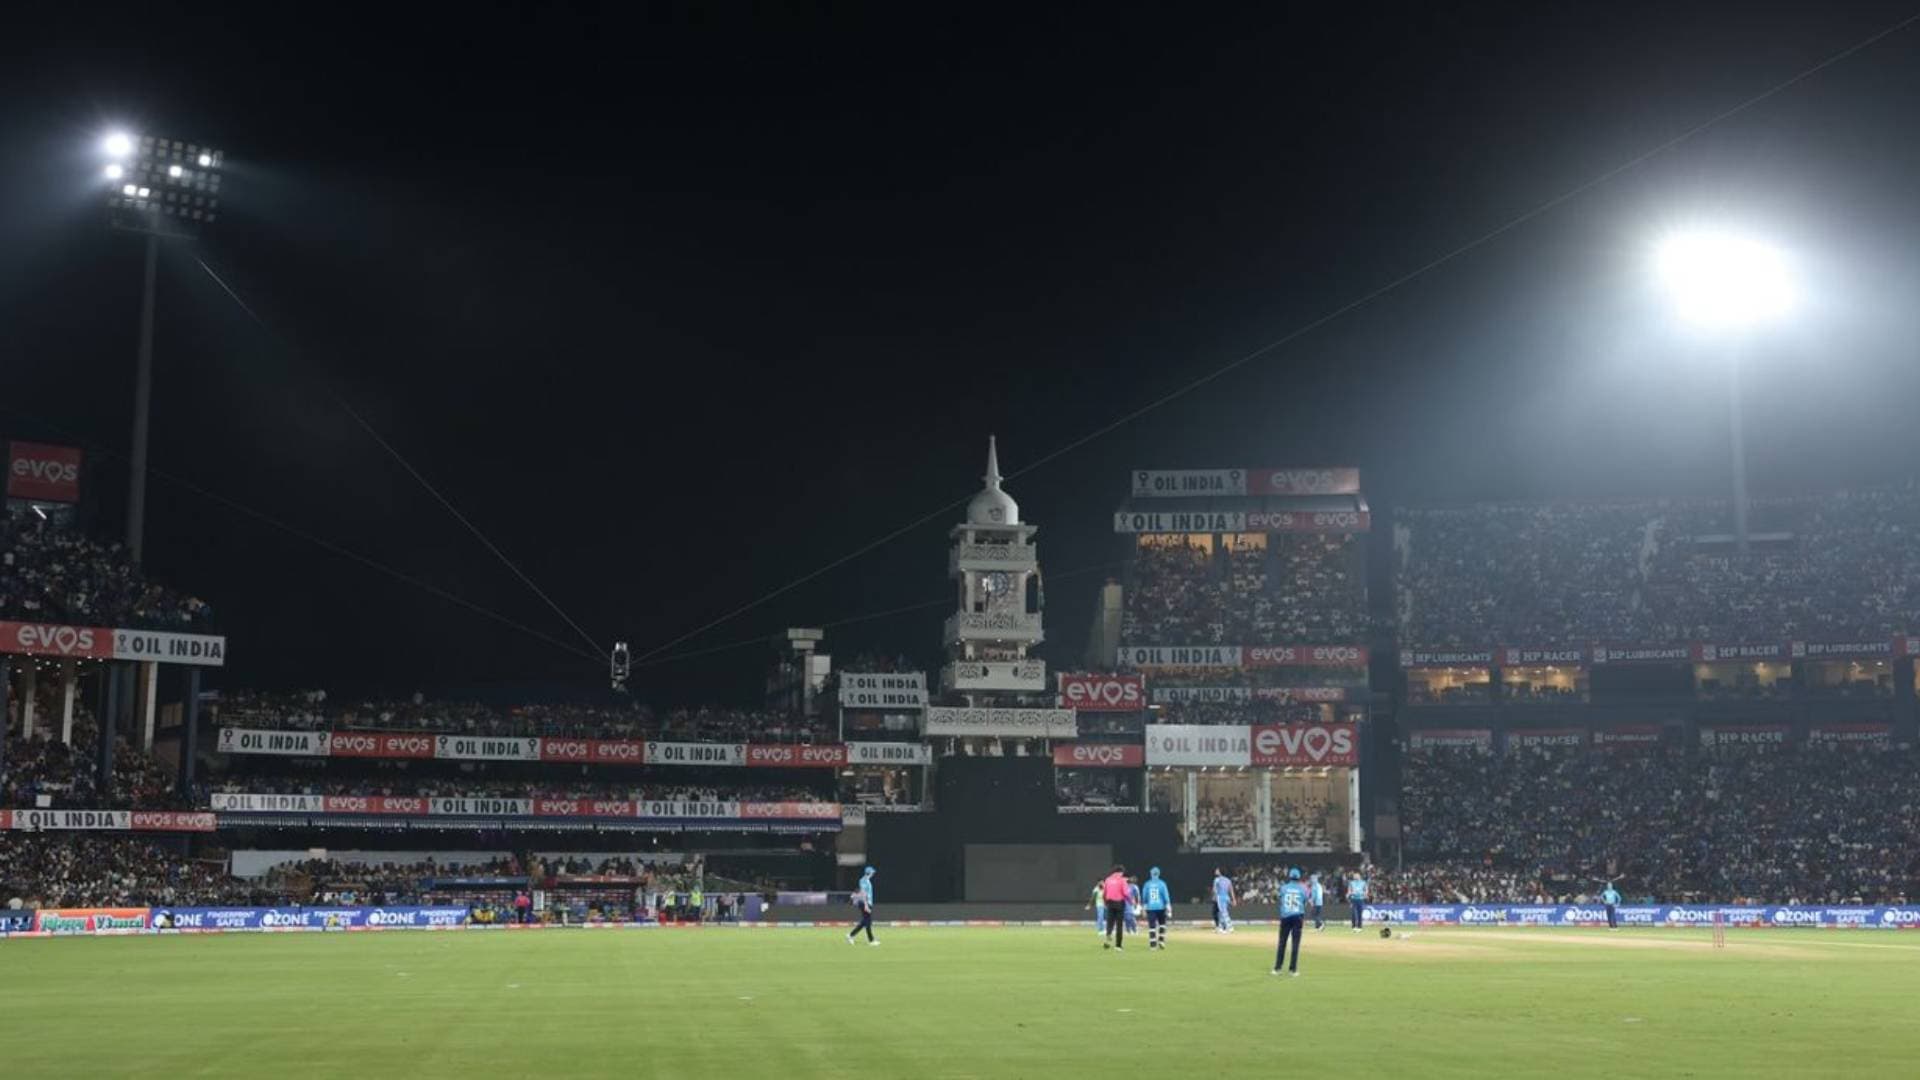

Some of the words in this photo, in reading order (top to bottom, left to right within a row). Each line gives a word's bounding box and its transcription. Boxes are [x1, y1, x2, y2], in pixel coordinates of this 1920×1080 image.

[13, 458, 78, 483] evos
[1155, 477, 1177, 490] OIL
[1182, 475, 1223, 490] INDIA
[1271, 471, 1334, 490] evos
[1132, 515, 1162, 530] OIL
[1172, 514, 1227, 529] INDIA
[1249, 512, 1293, 528] evos
[1313, 512, 1359, 528] evos
[17, 625, 94, 653] evos
[132, 636, 161, 655] OIL
[169, 639, 222, 659] INDIA
[1251, 647, 1295, 662] evos
[1313, 647, 1360, 662] evos
[1741, 645, 1778, 656] RACER
[1136, 650, 1163, 665] OIL
[1172, 650, 1222, 664] INDIA
[1544, 651, 1580, 661] RACER
[857, 678, 877, 689] OIL
[882, 678, 919, 689] INDIA
[859, 694, 877, 705] OIL
[883, 694, 919, 705] INDIA
[1067, 681, 1139, 704] evos
[240, 734, 263, 749] OIL
[268, 734, 310, 751] INDIA
[332, 737, 375, 752] evos
[386, 737, 430, 753] evos
[455, 741, 478, 755] OIL
[482, 741, 520, 755] INDIA
[545, 742, 587, 757] evos
[1163, 738, 1191, 753] OIL
[1199, 738, 1248, 753] INDIA
[1256, 727, 1352, 761] evos
[598, 743, 639, 758] evos
[664, 745, 685, 761] OIL
[689, 746, 727, 762] INDIA
[752, 748, 792, 763] evos
[802, 748, 843, 763] evos
[860, 748, 879, 759] OIL
[882, 748, 915, 760] INDIA
[1073, 746, 1123, 764] evos
[227, 797, 257, 810] OIL
[260, 798, 307, 811] INDIA
[328, 798, 367, 812] evos
[383, 798, 421, 812] evos
[443, 800, 468, 813] OIL
[474, 800, 519, 814] INDIA
[541, 801, 578, 815] evos
[594, 801, 630, 815] evos
[652, 801, 675, 816] OIL
[681, 801, 726, 816] INDIA
[746, 802, 783, 816] evos
[798, 802, 833, 816] evos
[30, 812, 58, 827] OIL
[65, 812, 115, 827] INDIA
[134, 813, 170, 827] evos
[175, 813, 214, 828] evos
[1284, 894, 1301, 912] 95
[428, 916, 457, 925] SAFES
[1565, 907, 1607, 921] OZON
[1836, 915, 1866, 923] SAFES
[215, 918, 245, 927] SAFES
